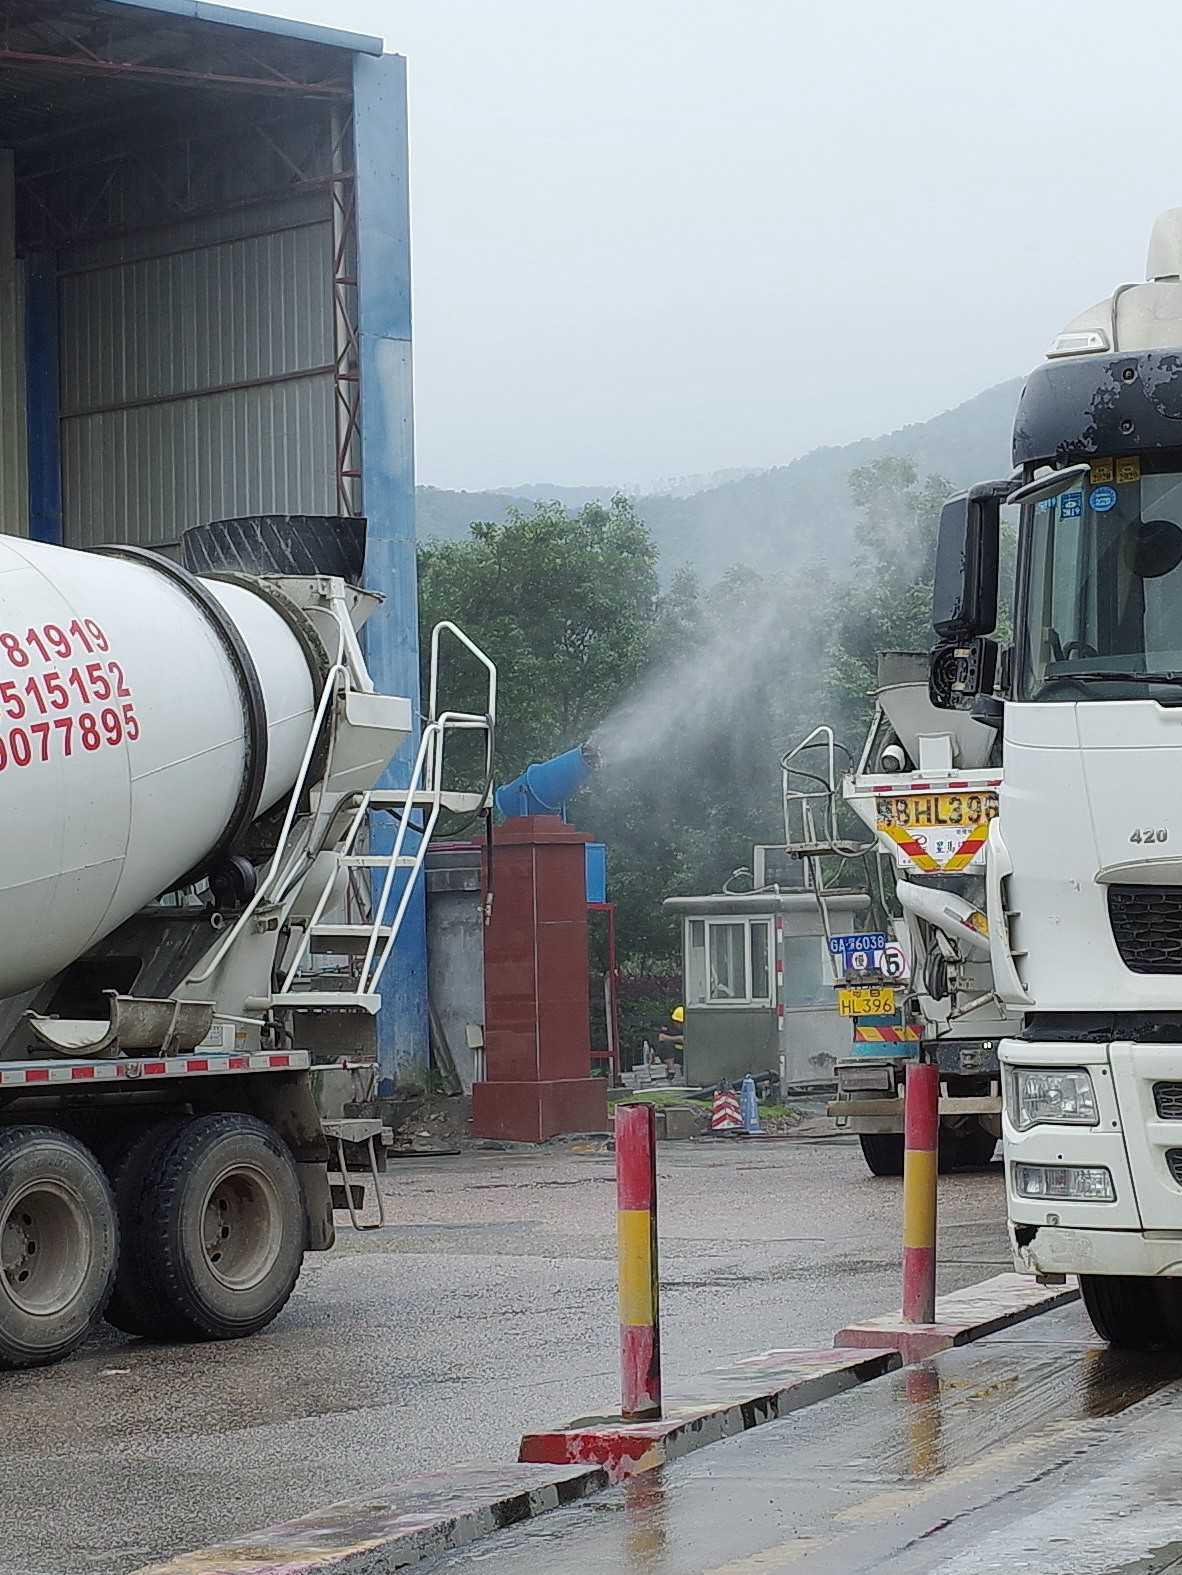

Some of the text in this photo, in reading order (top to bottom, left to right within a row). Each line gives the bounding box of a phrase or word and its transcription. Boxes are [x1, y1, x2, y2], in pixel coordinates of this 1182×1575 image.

[0, 618, 110, 668] 81919
[0, 661, 131, 720] 515152
[1129, 828, 1168, 844] 420
[841, 999, 893, 1015] HL396
